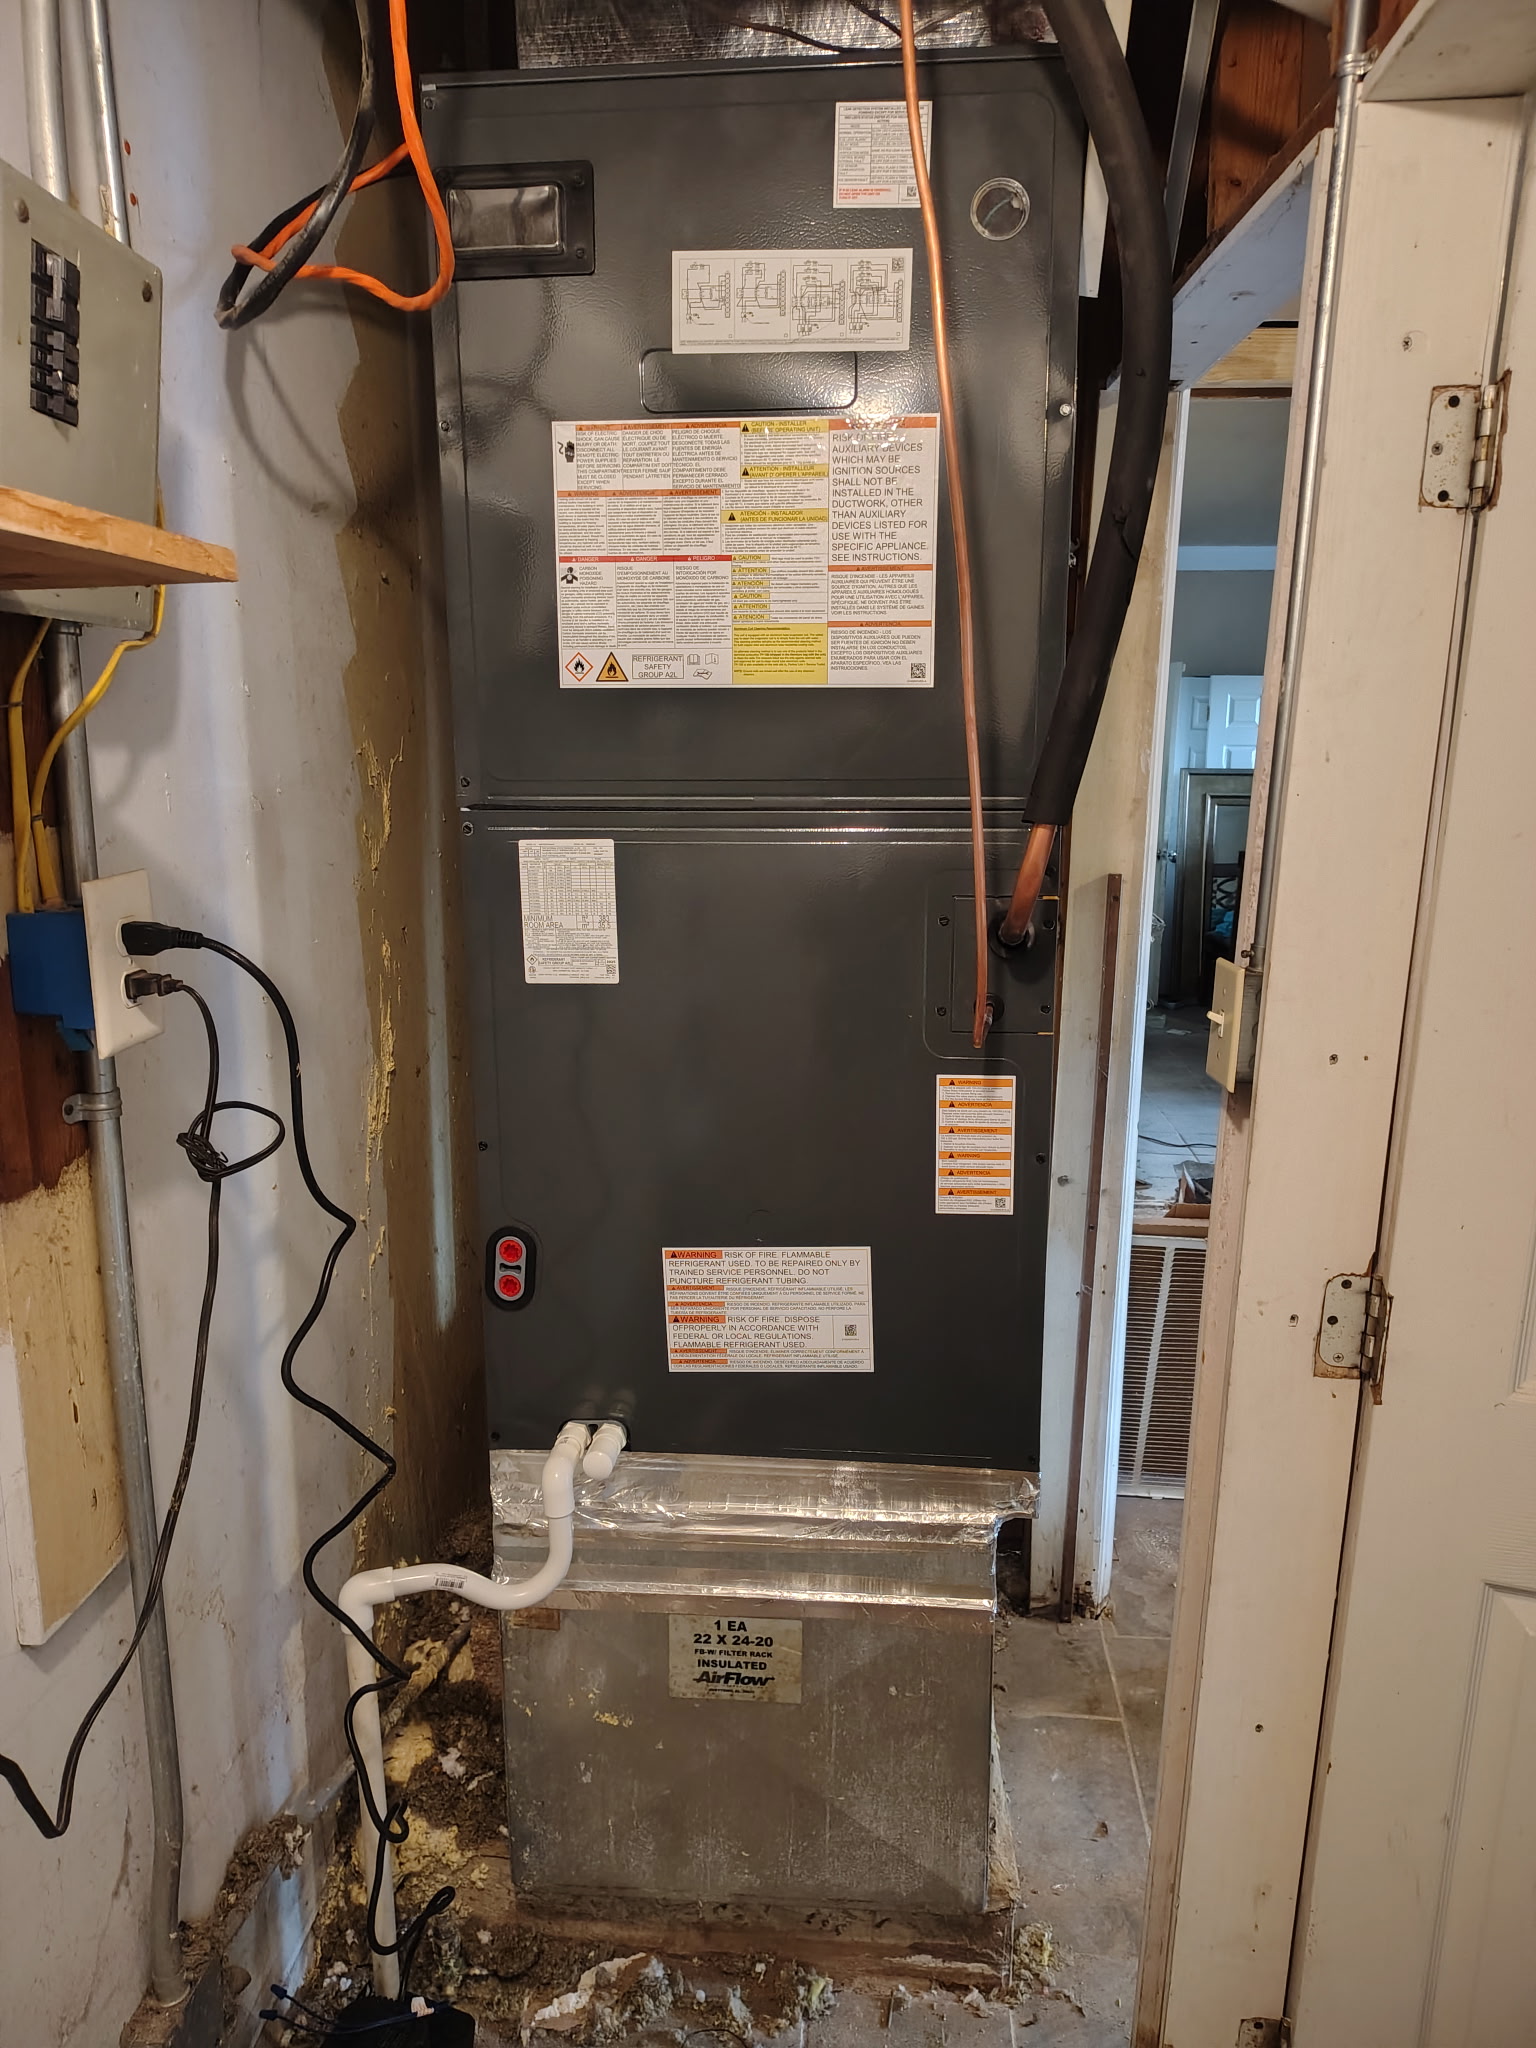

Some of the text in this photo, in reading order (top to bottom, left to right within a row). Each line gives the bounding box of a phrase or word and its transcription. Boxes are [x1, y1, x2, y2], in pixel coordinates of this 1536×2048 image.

[832, 434, 853, 442] RISK
[832, 444, 879, 453] AUXILIARY
[832, 454, 900, 464] WHICH MAY BE
[832, 466, 920, 475] IGNITION SOURCES
[832, 477, 897, 486] SHALL NOT BE
[832, 488, 914, 497] INSTALLED IN THE
[832, 499, 887, 508] DUCTWORK,
[890, 498, 923, 507] OTHER
[832, 509, 906, 519] THAN AUXILIARY
[832, 520, 928, 529] DEVICES LISTED FOR
[832, 531, 897, 540] USE WITH THE
[832, 542, 928, 551] SPECIFIC APPLIANCE.
[832, 553, 849, 562] SEE
[852, 552, 922, 561] INSTRUCTIONS.
[644, 663, 671, 671] SAFETY
[638, 671, 662, 679] GROUP
[523, 914, 553, 922] MINIMUM
[677, 1251, 716, 1259] WARNING
[724, 1251, 742, 1259] RISK
[745, 1251, 755, 1259] OF
[781, 1251, 831, 1259] FLAMMABLE
[669, 1268, 830, 1276] TRAINED SERVICE PERSONNEL. DO NOT
[670, 1277, 808, 1285] PUNCTURE REFRIGERANT TUBING.
[728, 1324, 736, 1332] IN
[738, 1324, 795, 1332] ACCORDANCE
[797, 1324, 819, 1332] WITH
[714, 1620, 747, 1632] 1 EA
[693, 1633, 773, 1647] 22 X 24-20
[697, 1659, 767, 1670] INSULATED
[693, 1670, 775, 1686] AirFlow
